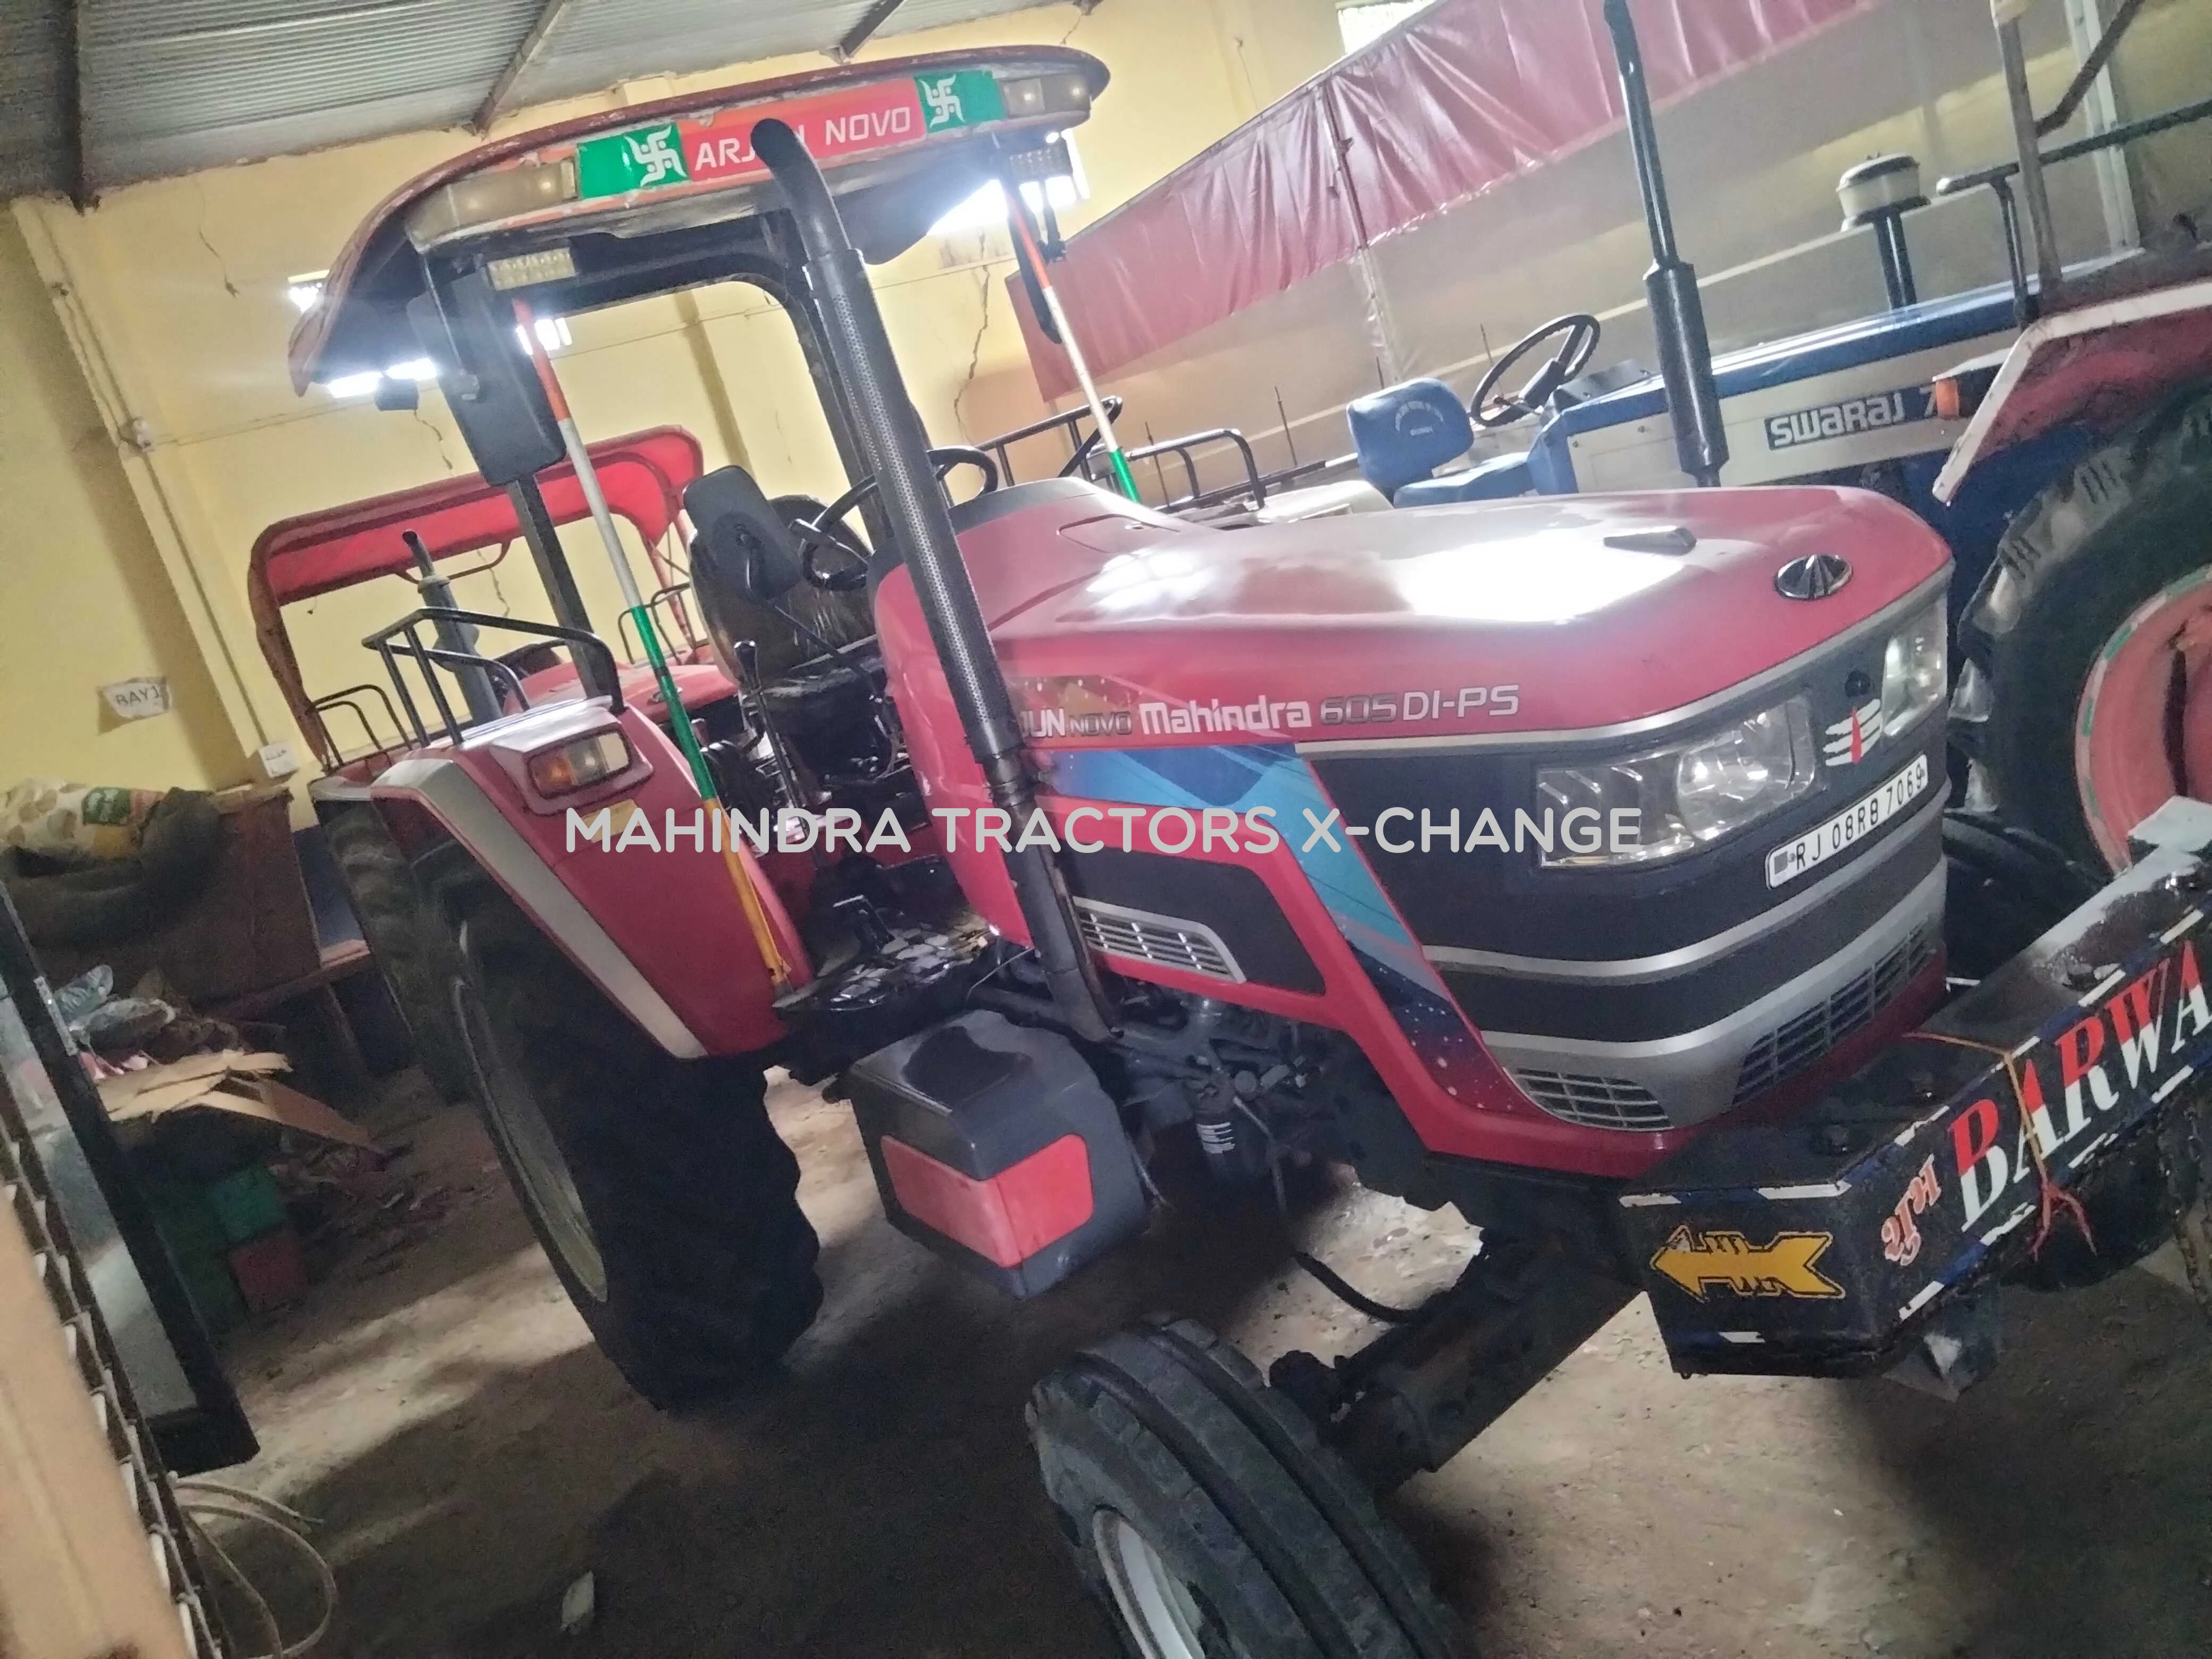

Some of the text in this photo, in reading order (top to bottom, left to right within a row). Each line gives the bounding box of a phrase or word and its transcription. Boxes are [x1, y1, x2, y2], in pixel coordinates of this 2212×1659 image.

[694, 106, 911, 172] ARJ NOVO
[1068, 711, 1132, 736] NOVO
[1139, 693, 1312, 735] Mahindra
[1319, 692, 1397, 726] 605
[1402, 684, 1520, 722] DI-PS
